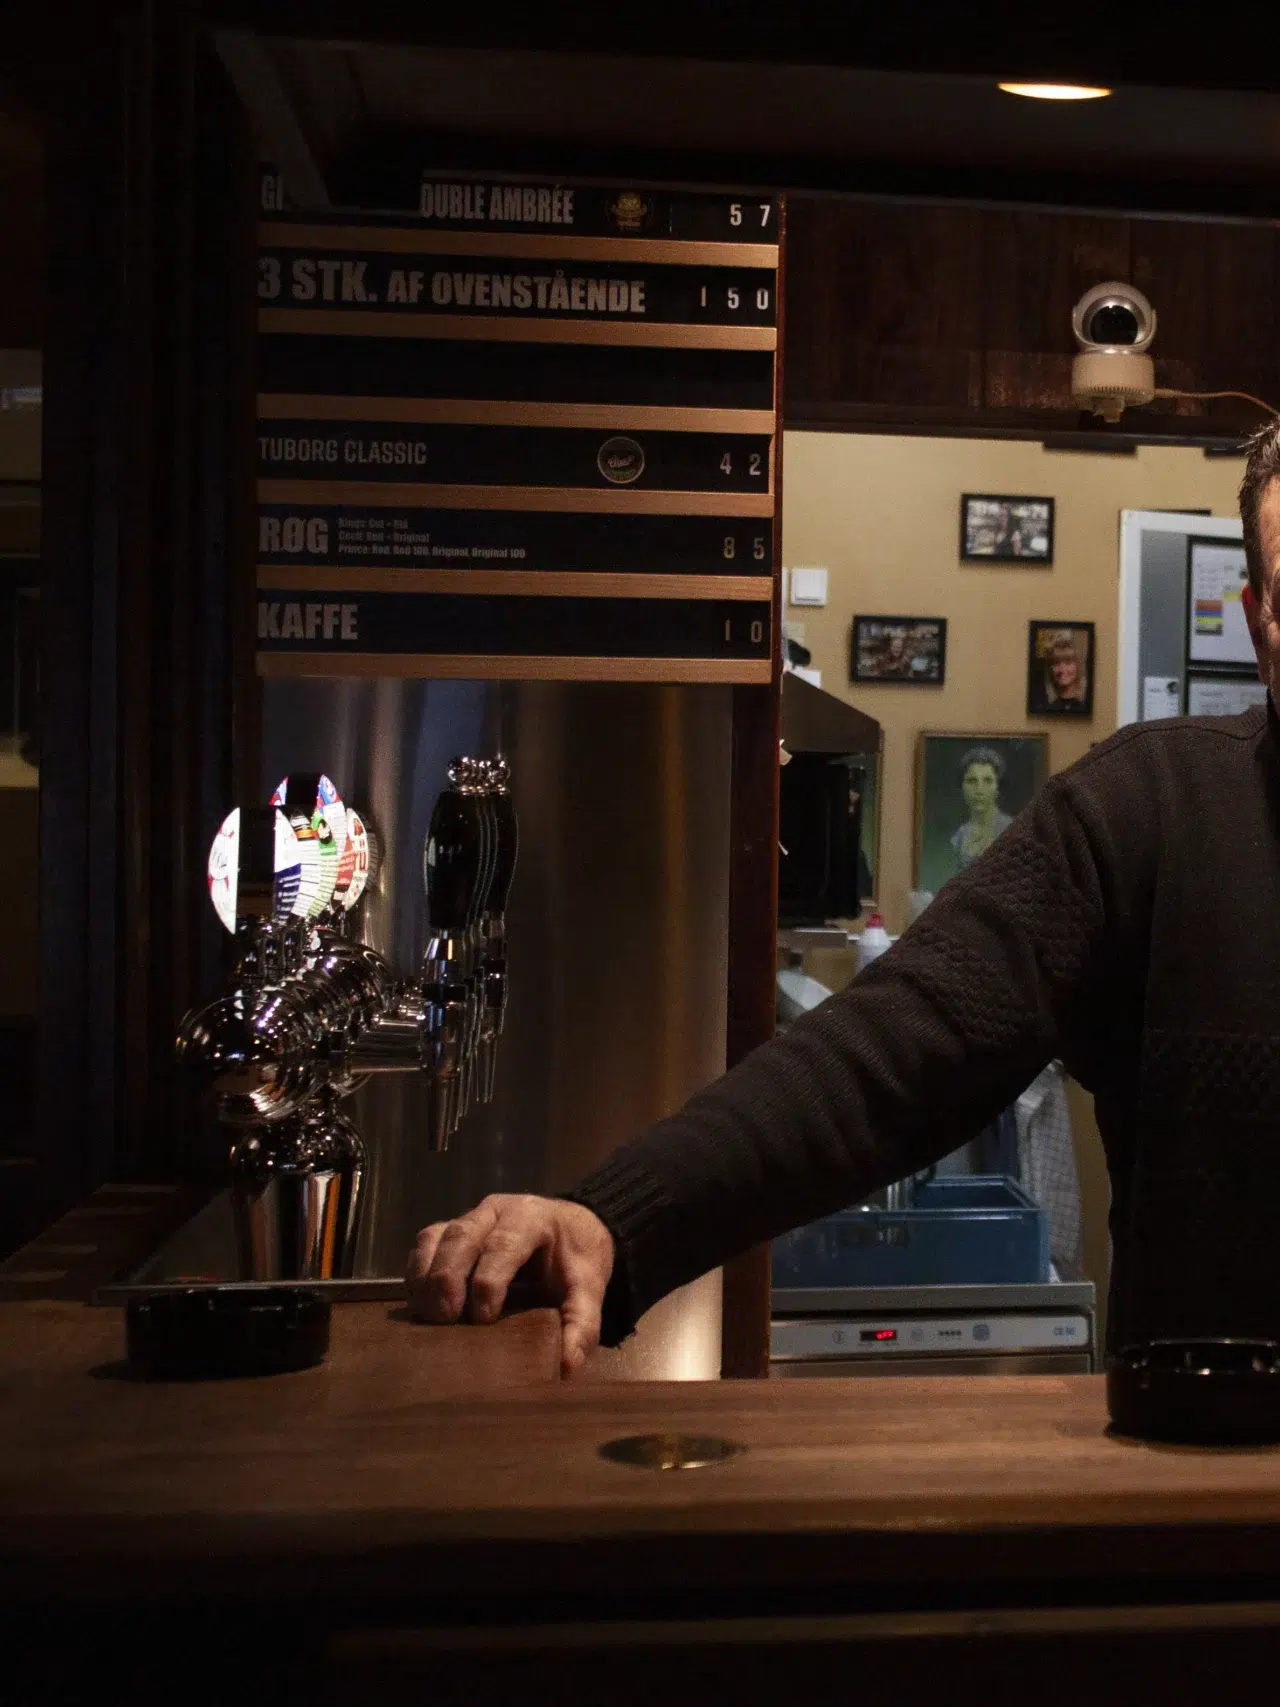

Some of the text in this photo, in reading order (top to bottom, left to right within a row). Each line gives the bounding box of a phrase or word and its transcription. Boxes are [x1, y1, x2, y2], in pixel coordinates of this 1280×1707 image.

[489, 184, 576, 225] AMBRÉE
[256, 257, 282, 300] 3
[291, 257, 378, 304] STK.
[387, 270, 424, 304] AF
[431, 268, 647, 314] OVENSTÅENDE
[257, 437, 338, 462] TUBORG
[344, 440, 428, 465] CLASSIC
[259, 516, 329, 554] RØG
[257, 601, 360, 641] KAFFE
